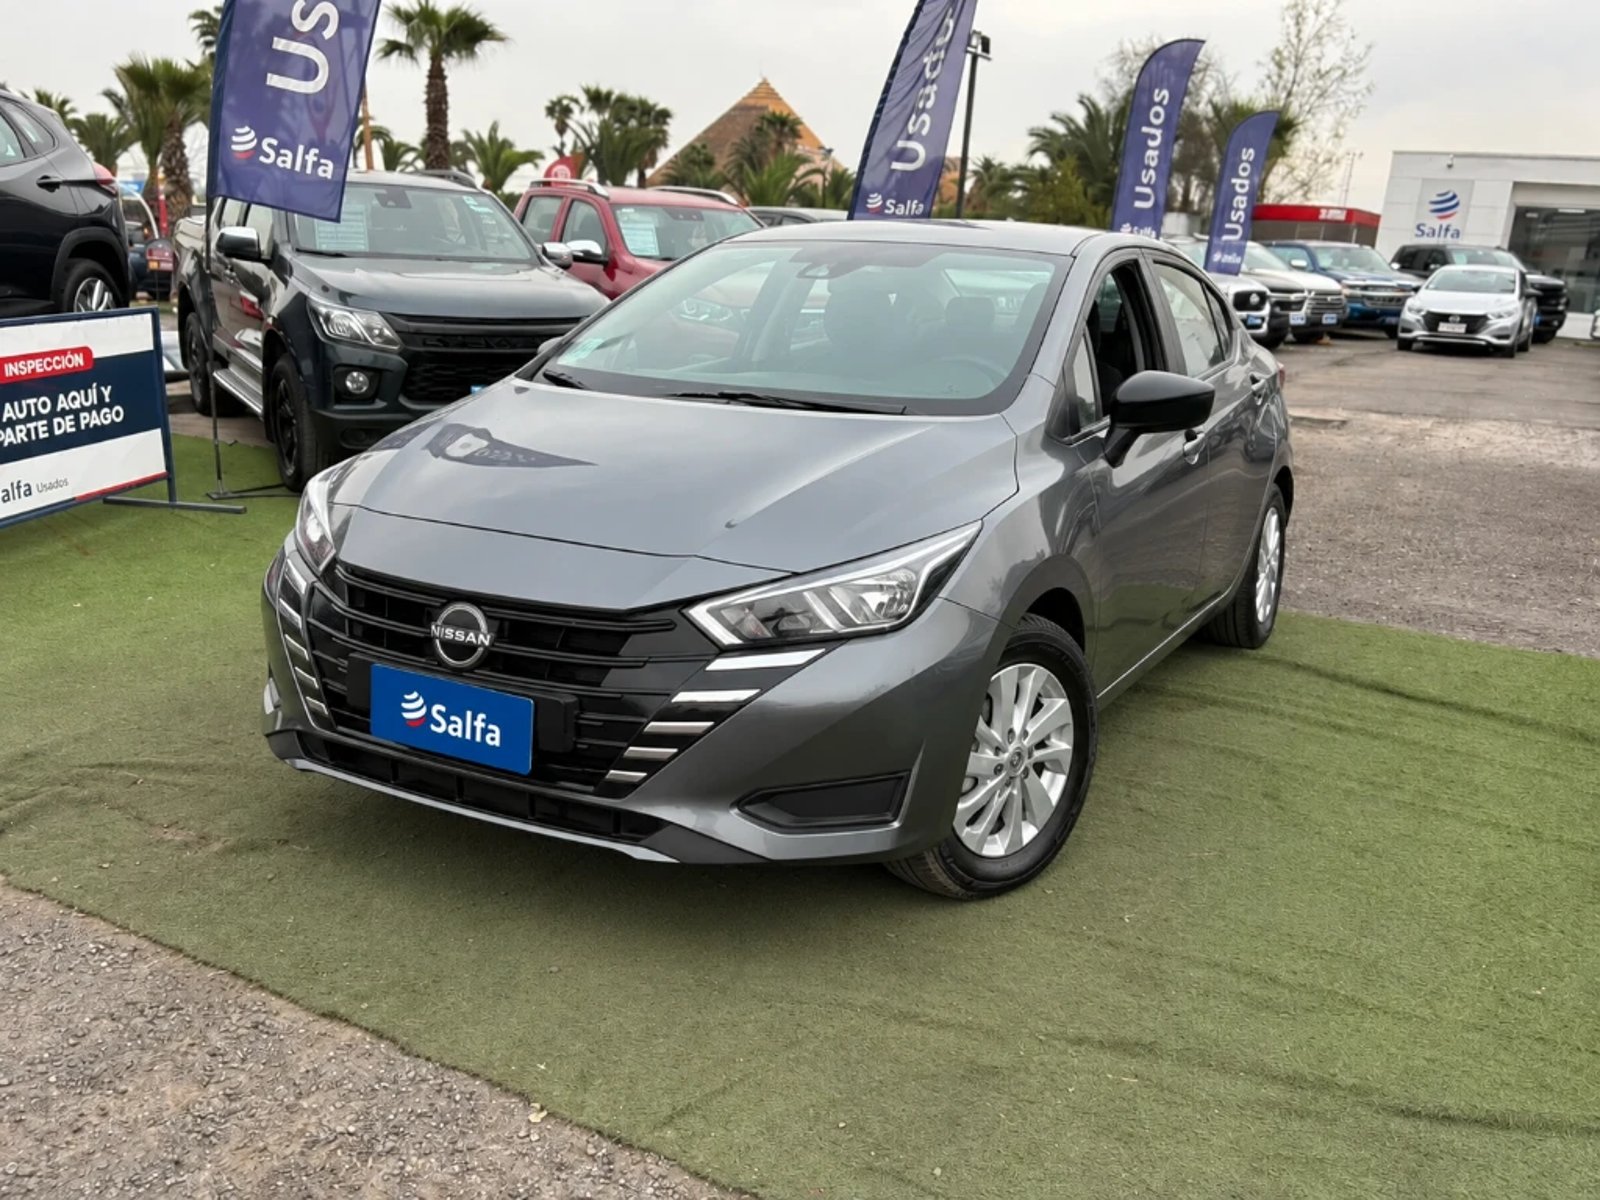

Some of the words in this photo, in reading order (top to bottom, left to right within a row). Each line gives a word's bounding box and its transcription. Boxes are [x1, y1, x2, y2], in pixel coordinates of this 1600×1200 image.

[259, 137, 335, 180] Salfa
[1134, 88, 1169, 209] Usados
[884, 198, 924, 216] Salfa
[1221, 147, 1255, 240] Usados
[1415, 223, 1461, 239] Salfa
[4, 352, 85, 377] INSPECCIÓN
[2, 396, 52, 422] AUTO
[56, 382, 98, 412] AQUÍ
[101, 385, 112, 402] Y
[53, 415, 76, 436] DE
[80, 405, 125, 430] PAGO
[36, 477, 69, 493] Usados
[430, 623, 492, 647] NISSAN
[430, 703, 501, 748] Salfa
